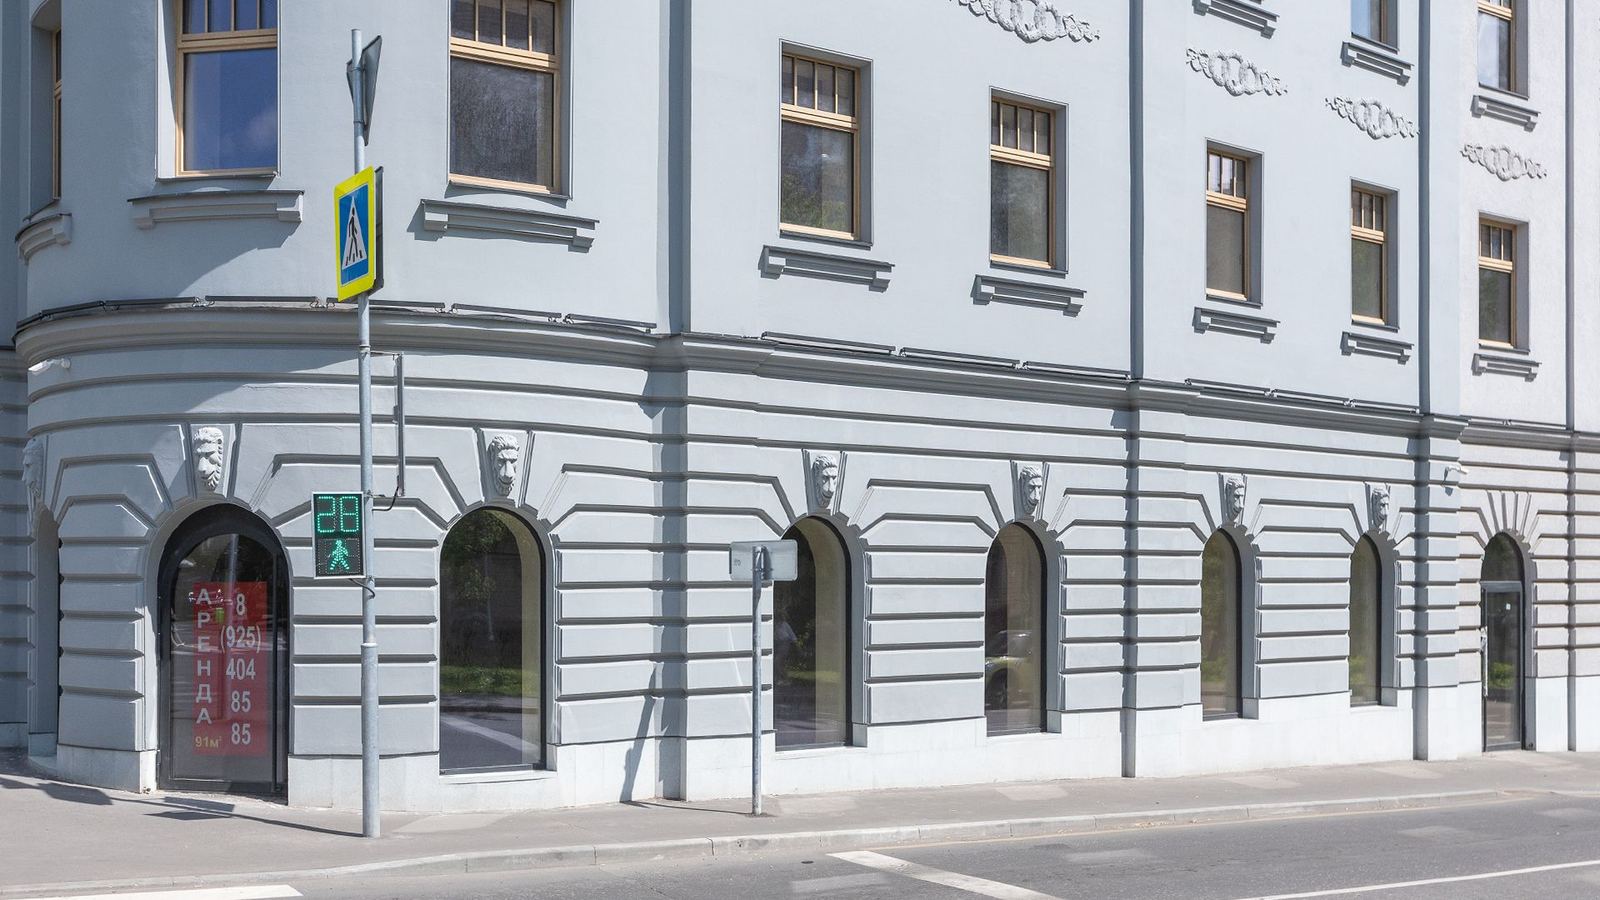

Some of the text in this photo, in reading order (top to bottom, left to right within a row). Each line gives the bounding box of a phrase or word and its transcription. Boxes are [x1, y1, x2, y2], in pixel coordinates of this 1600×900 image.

[317, 496, 359, 533] 28
[236, 593, 246, 616] 8
[221, 625, 261, 654] (925)
[195, 588, 212, 724] АРЕНДА
[226, 658, 256, 680] 404
[231, 690, 251, 713] 85
[231, 722, 251, 745] 85
